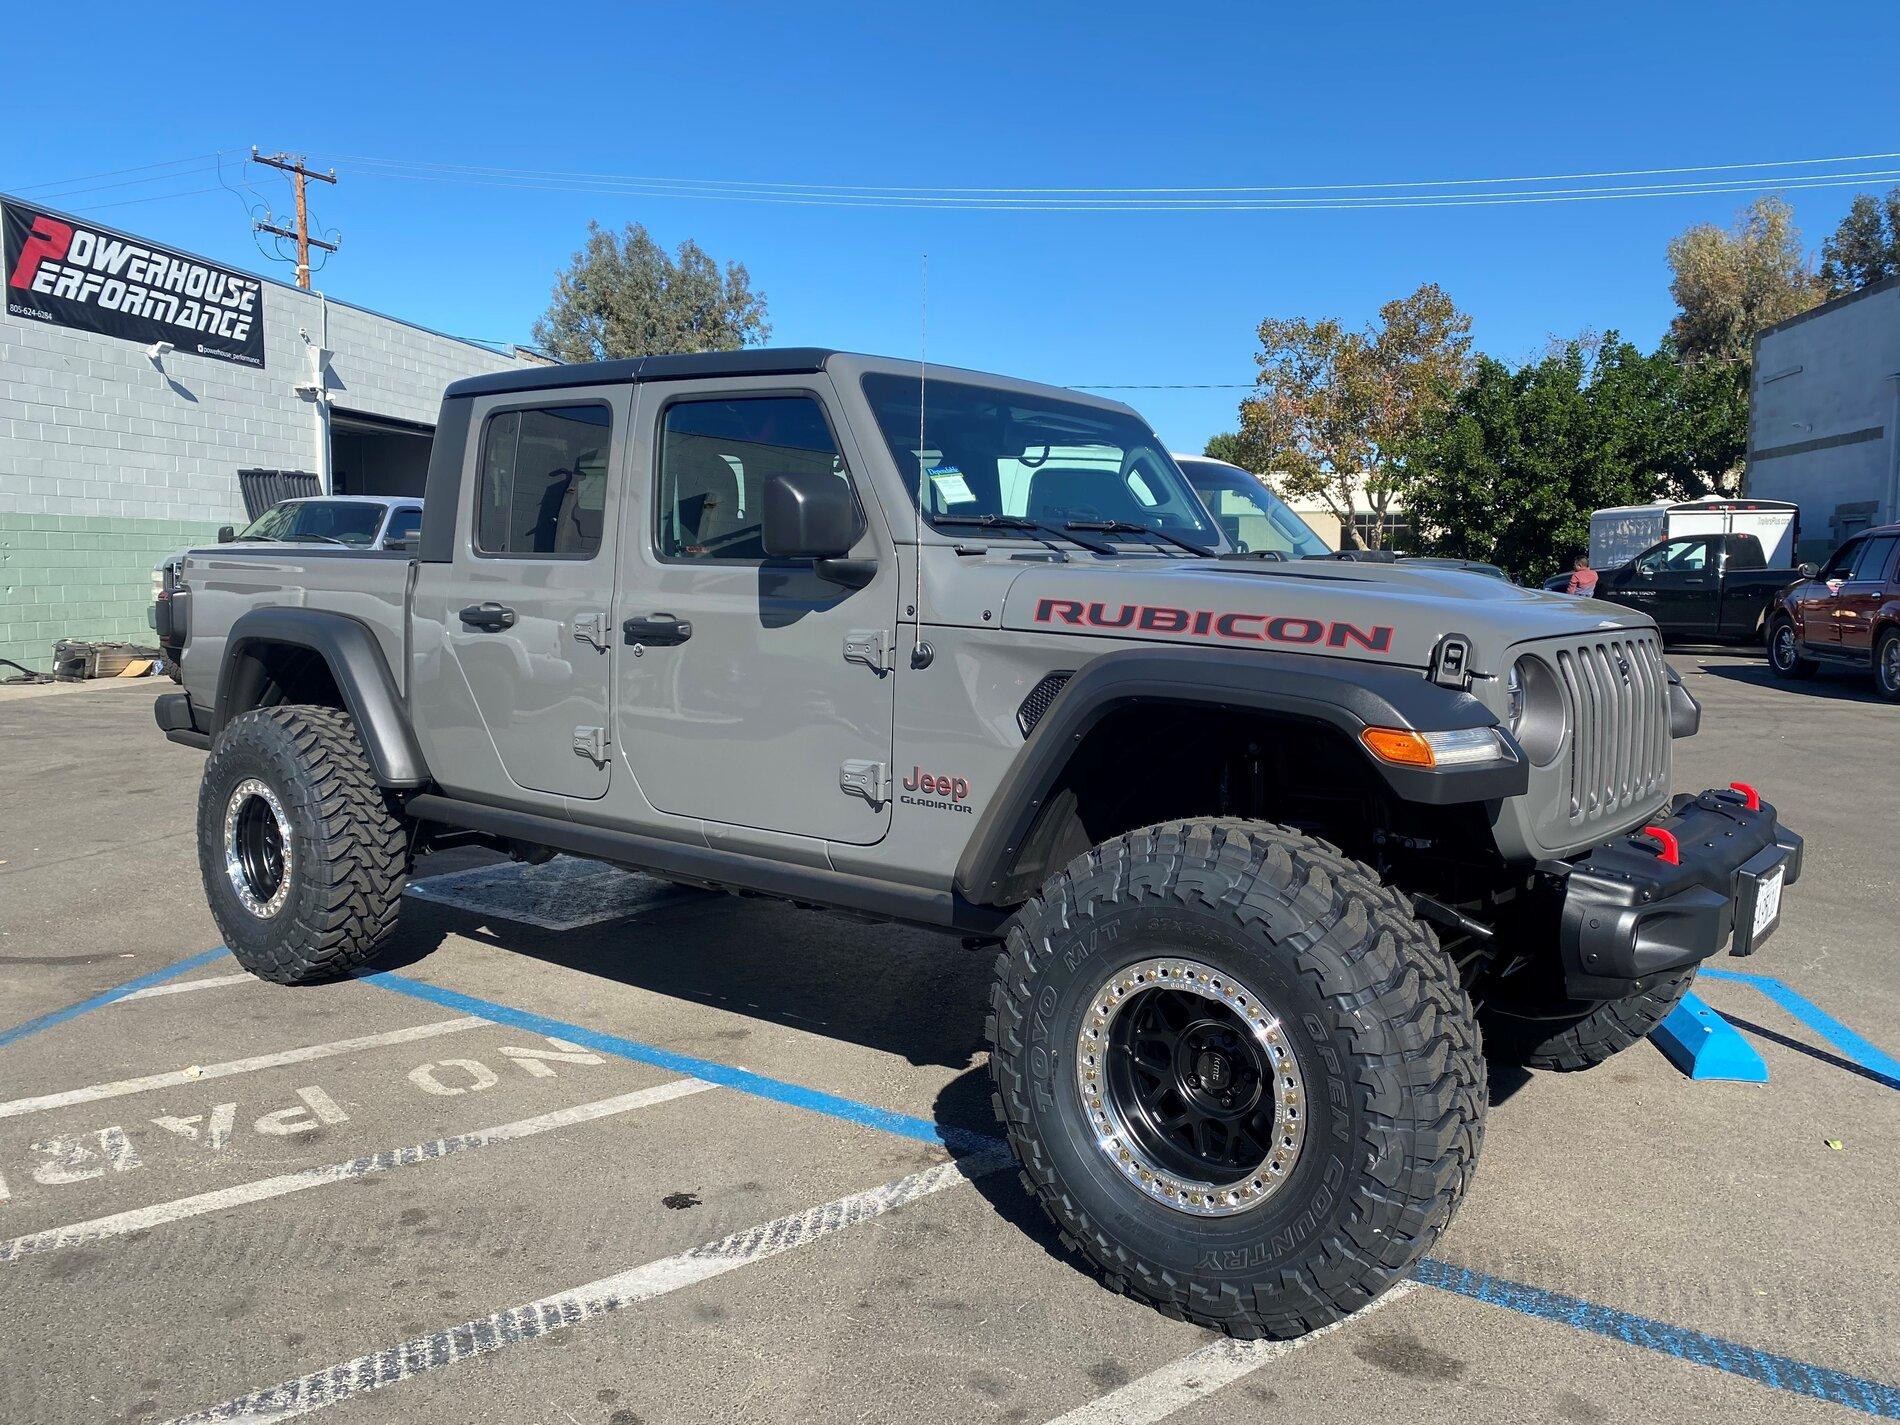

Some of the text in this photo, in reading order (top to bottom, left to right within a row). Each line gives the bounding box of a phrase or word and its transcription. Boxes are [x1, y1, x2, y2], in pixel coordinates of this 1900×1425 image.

[10, 215, 261, 312] POWERHOUSE
[10, 303, 53, 320] 805-624-6284
[1034, 598, 1394, 653] RUBICON
[900, 795, 973, 815] GLADIATOR
[902, 766, 970, 802] Jeep
[1030, 918, 1121, 1114] TOYO M/T
[0, 1036, 607, 1200] NO PAR
[1194, 1012, 1350, 1272] OPEN COUNTRY
